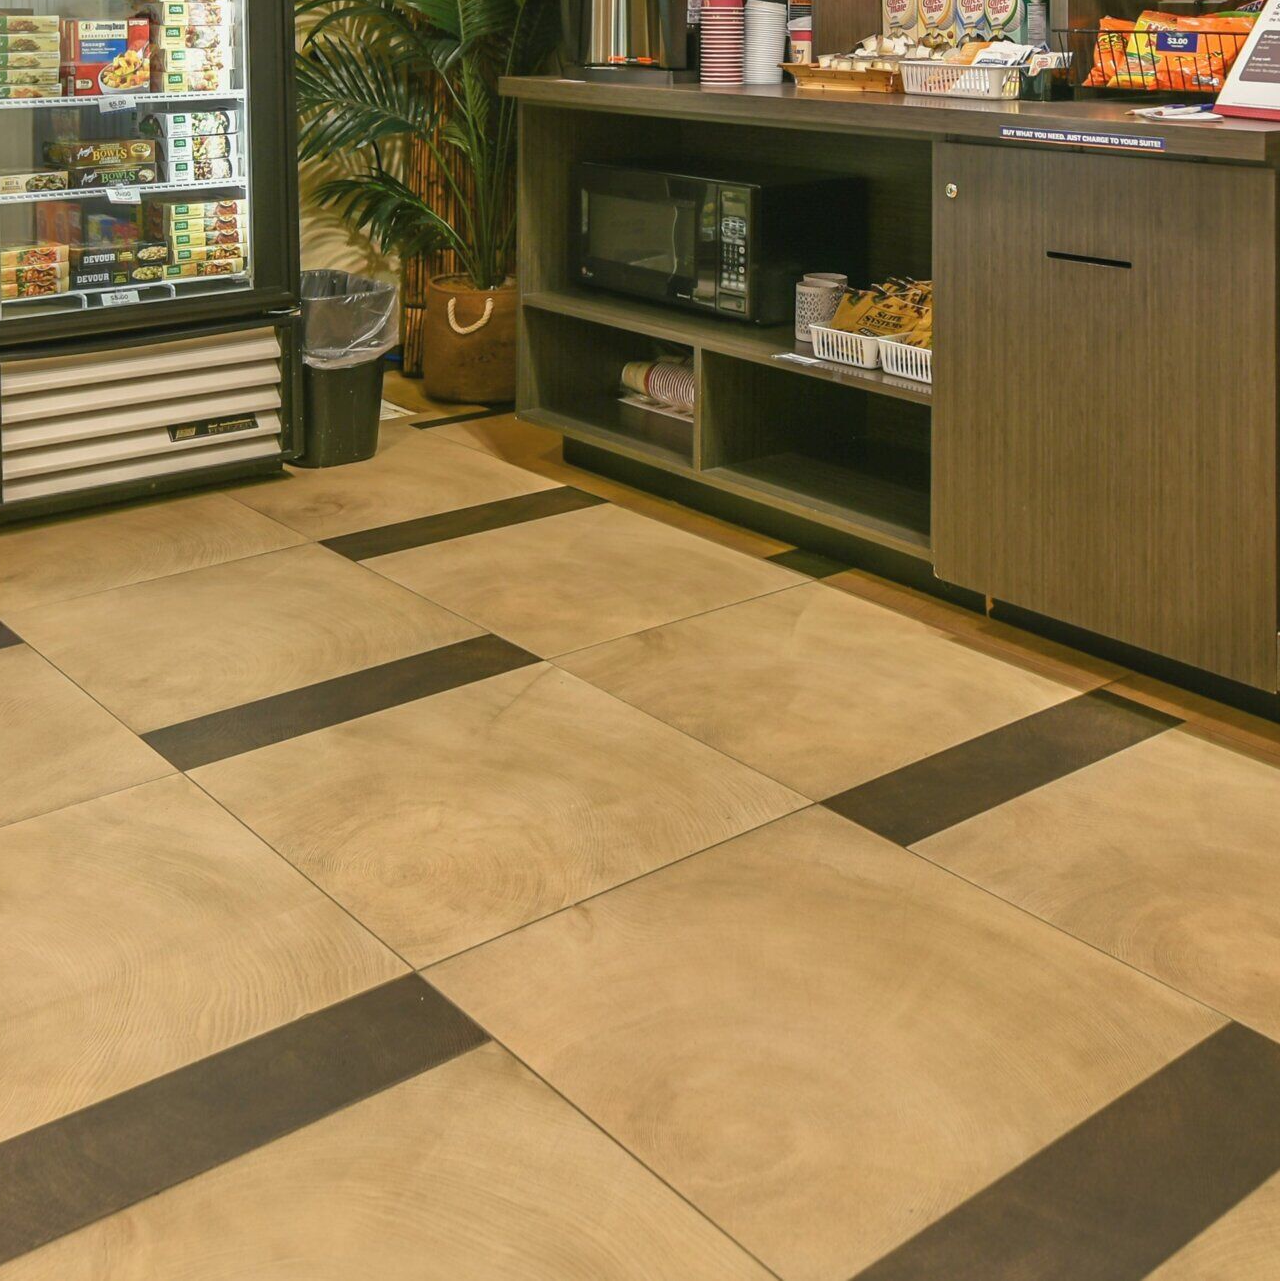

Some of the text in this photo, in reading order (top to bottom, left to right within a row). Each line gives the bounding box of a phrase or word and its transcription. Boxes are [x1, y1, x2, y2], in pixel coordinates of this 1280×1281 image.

[94, 23, 125, 31] Jimmy Dean
[1167, 37, 1189, 46] $3.00
[109, 99, 127, 108] $5.00
[1016, 130, 1033, 138] WHAT
[1082, 136, 1109, 144] CHARGE
[1120, 138, 1138, 146] YOUR
[93, 148, 127, 161] BOWLS
[101, 170, 135, 183] BOWLS
[83, 253, 116, 264] DEVOUR
[77, 273, 109, 284] DEVOUR
